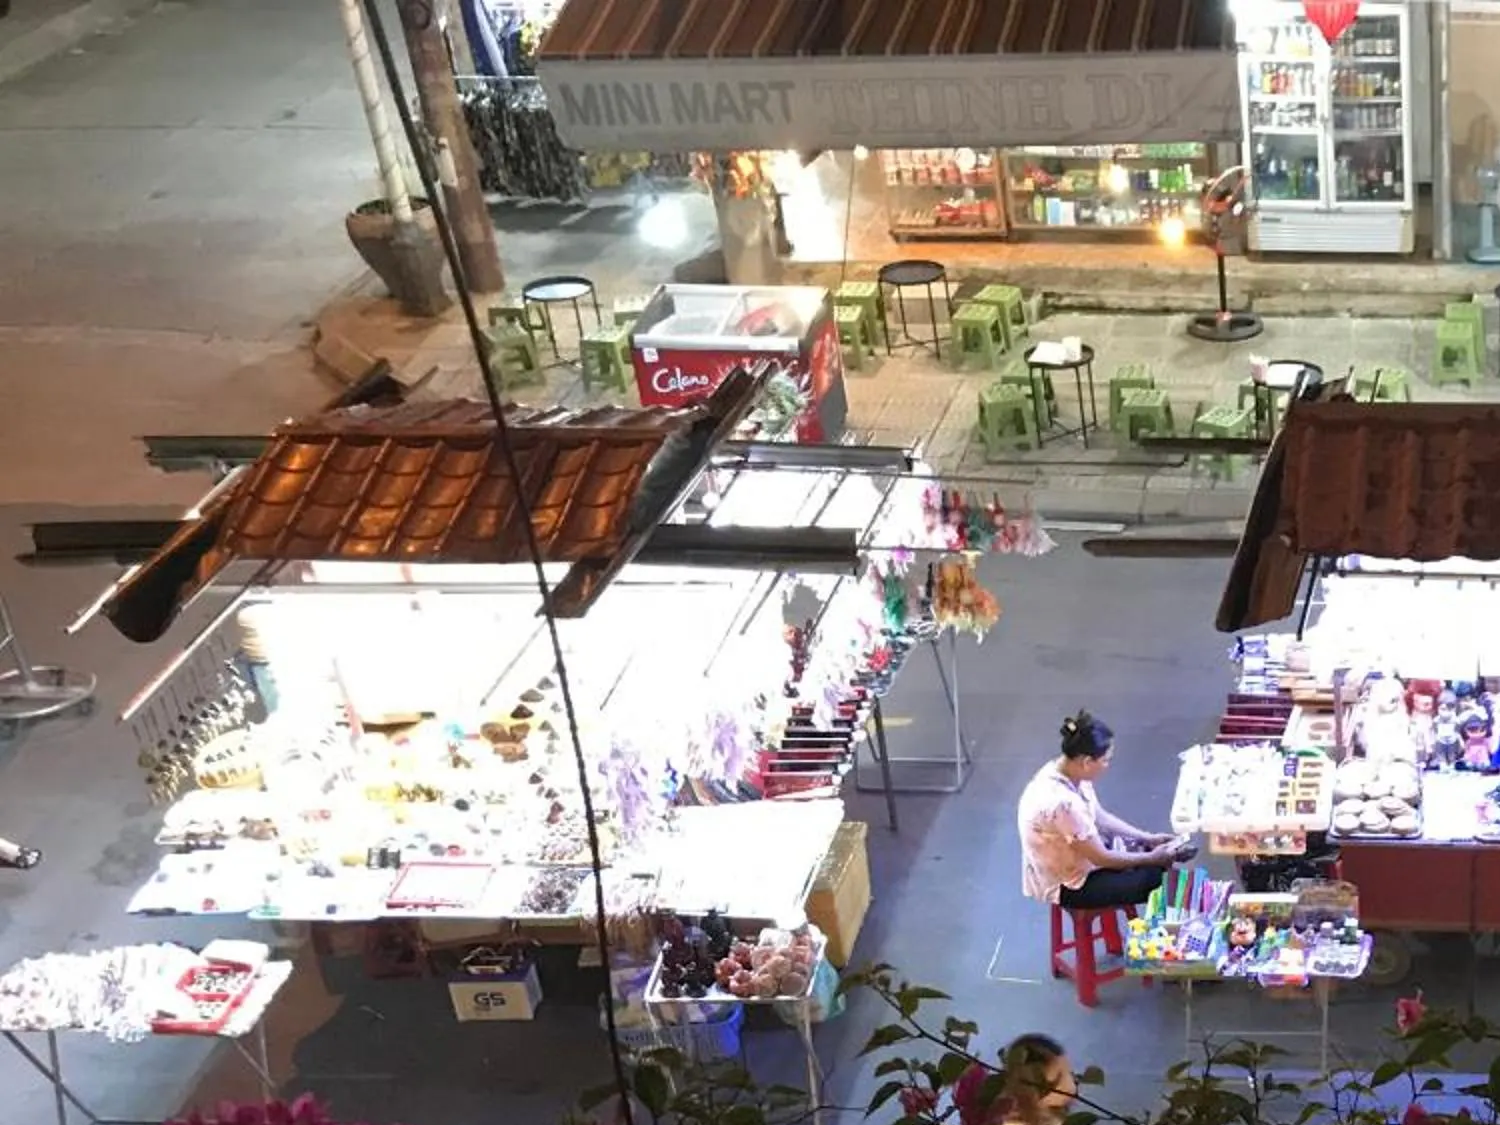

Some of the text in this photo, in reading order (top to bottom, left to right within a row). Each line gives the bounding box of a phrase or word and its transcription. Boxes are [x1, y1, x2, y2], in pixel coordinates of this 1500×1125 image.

[558, 82, 661, 126] MINI
[669, 81, 796, 126] MART
[473, 992, 507, 1007] GS
